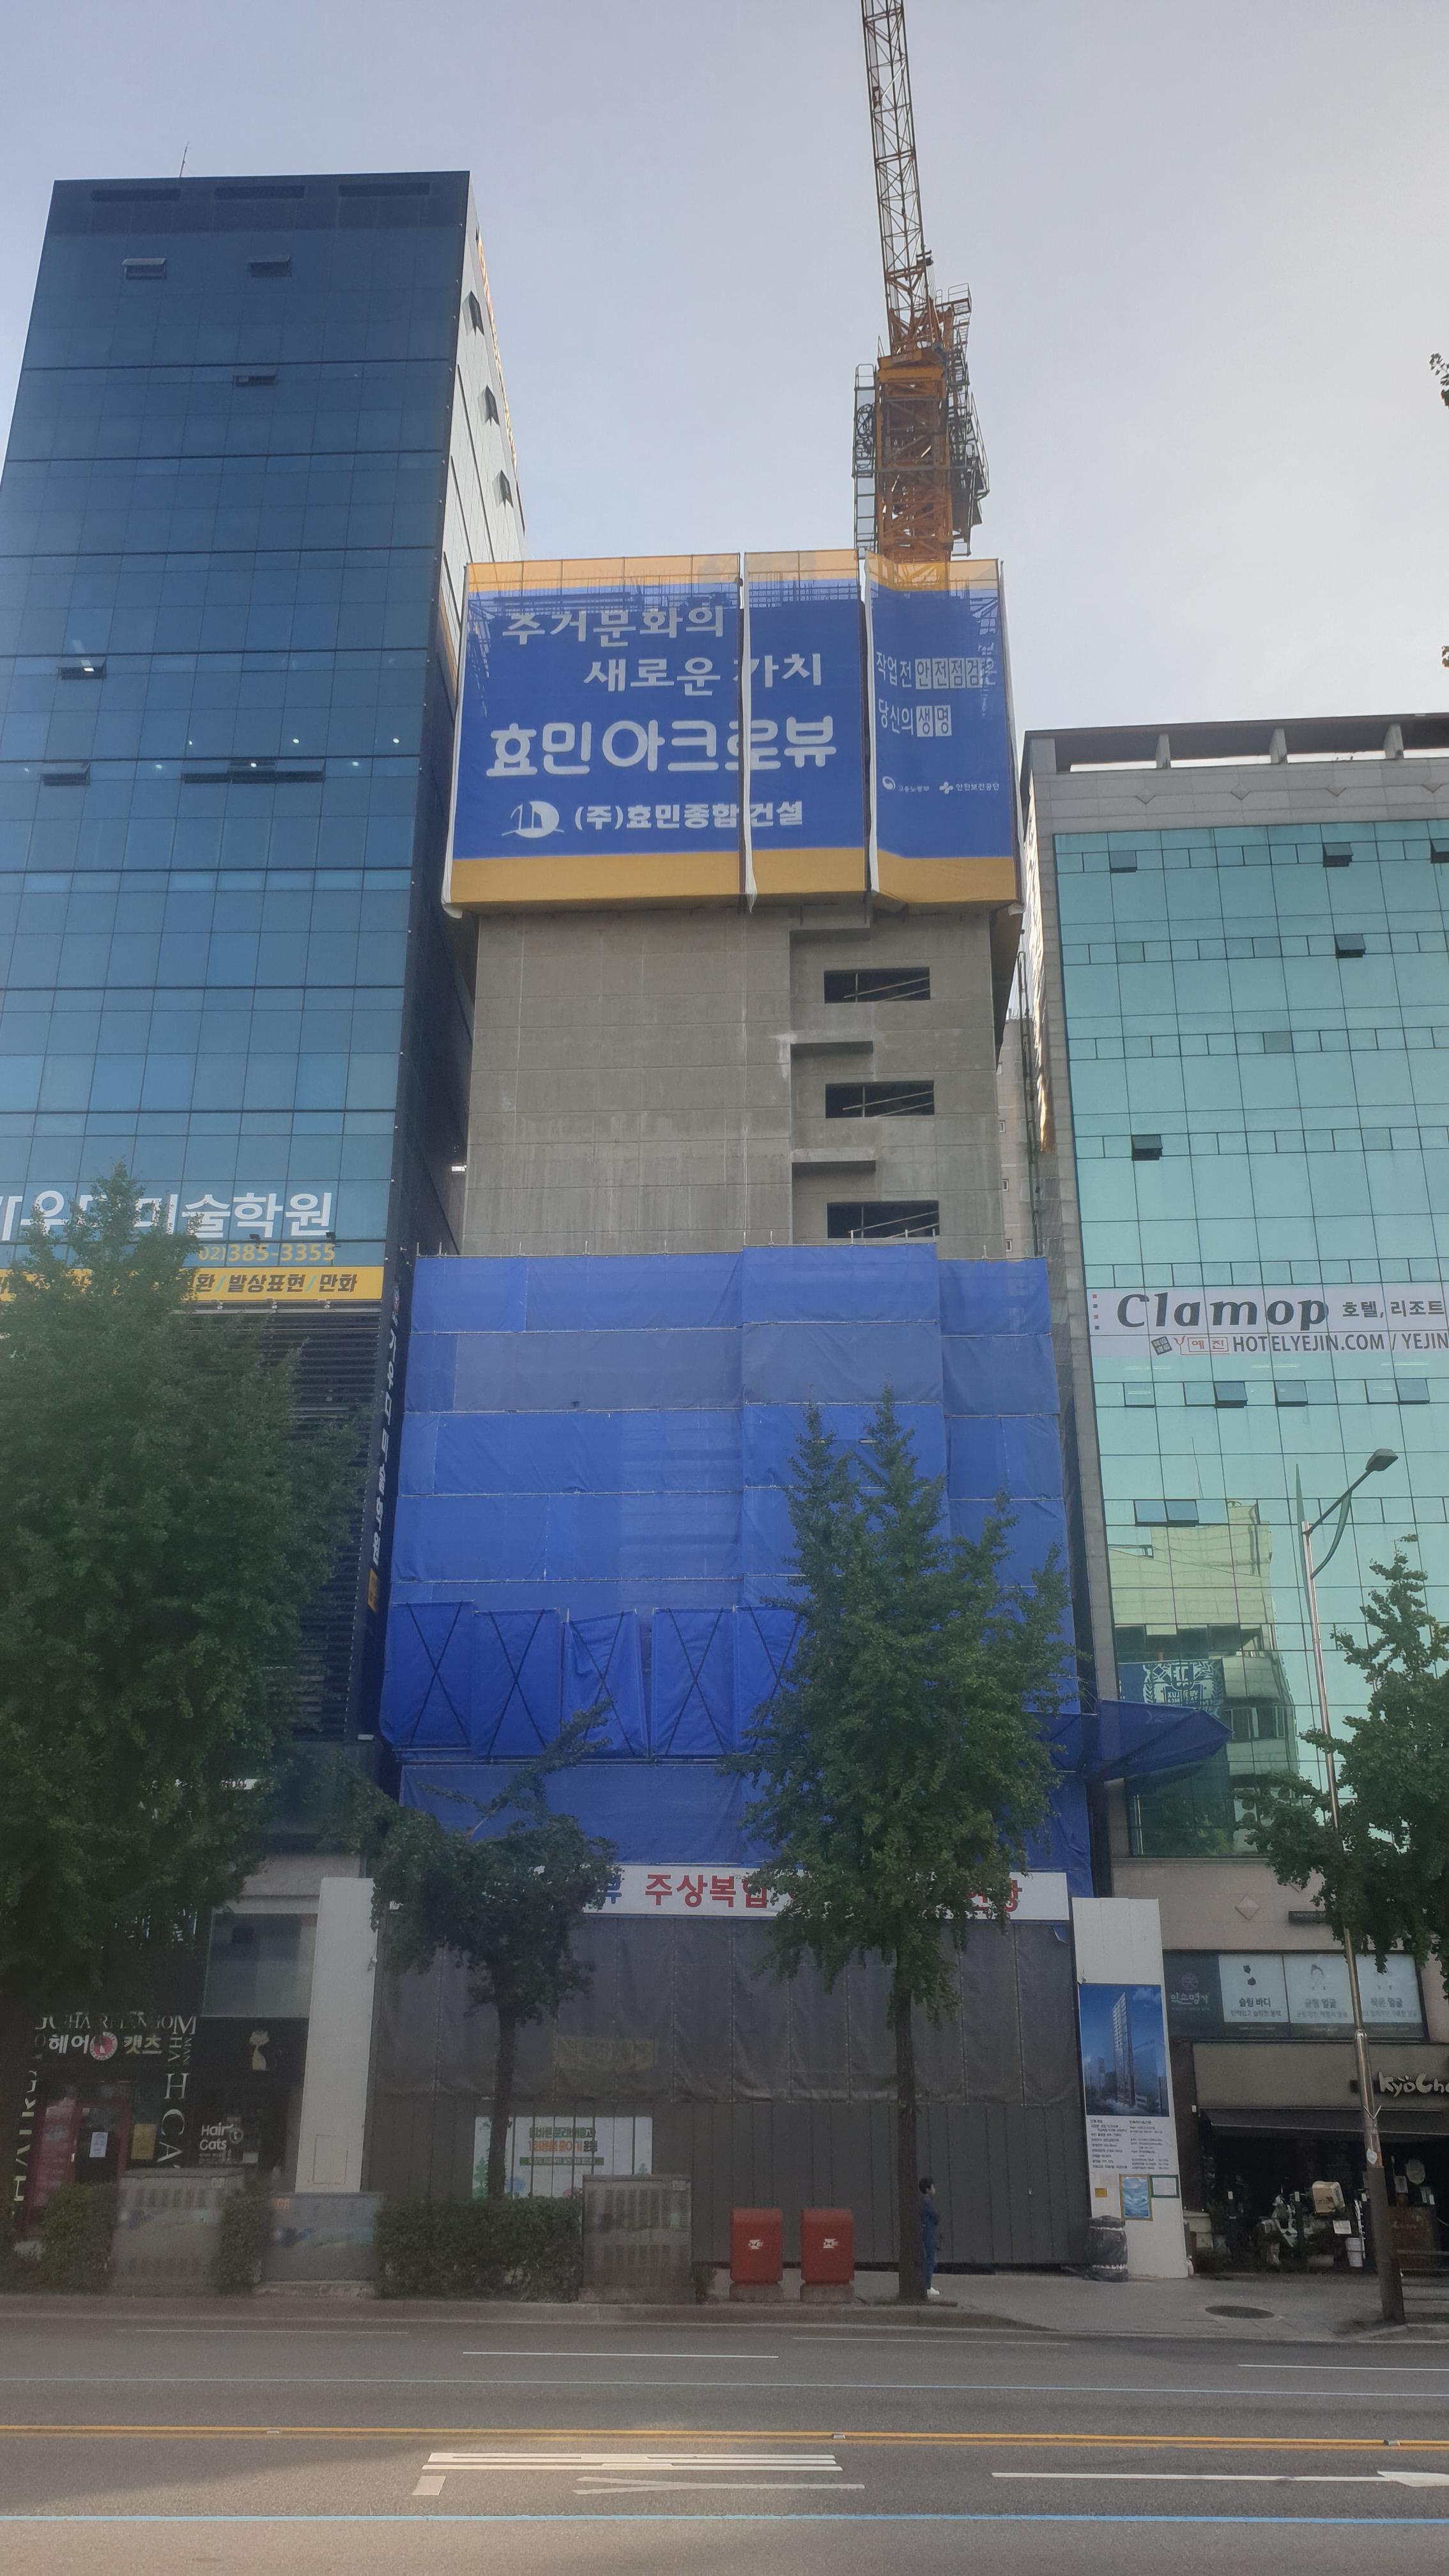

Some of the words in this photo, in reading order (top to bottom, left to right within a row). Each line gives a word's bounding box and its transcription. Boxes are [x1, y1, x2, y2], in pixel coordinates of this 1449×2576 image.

[502, 606, 723, 647] 주거문화의
[584, 657, 721, 696] 새로운
[733, 653, 822, 687] 가치
[878, 698, 914, 736] 당신의
[917, 706, 951, 736] 생명
[486, 716, 837, 777] 효민아크로뷰
[1117, 1292, 1330, 1331] Clamop
[1390, 1300, 1445, 1317] 리조트
[1233, 1333, 1385, 1353] HOTELYEJIN.COM
[1255, 1997, 1271, 2007] 바디
[49, 2034, 90, 2054] 헤어
[123, 2034, 163, 2055] 캣츠
[201, 2122, 234, 2136] Hair
[199, 2138, 227, 2151] Cats
